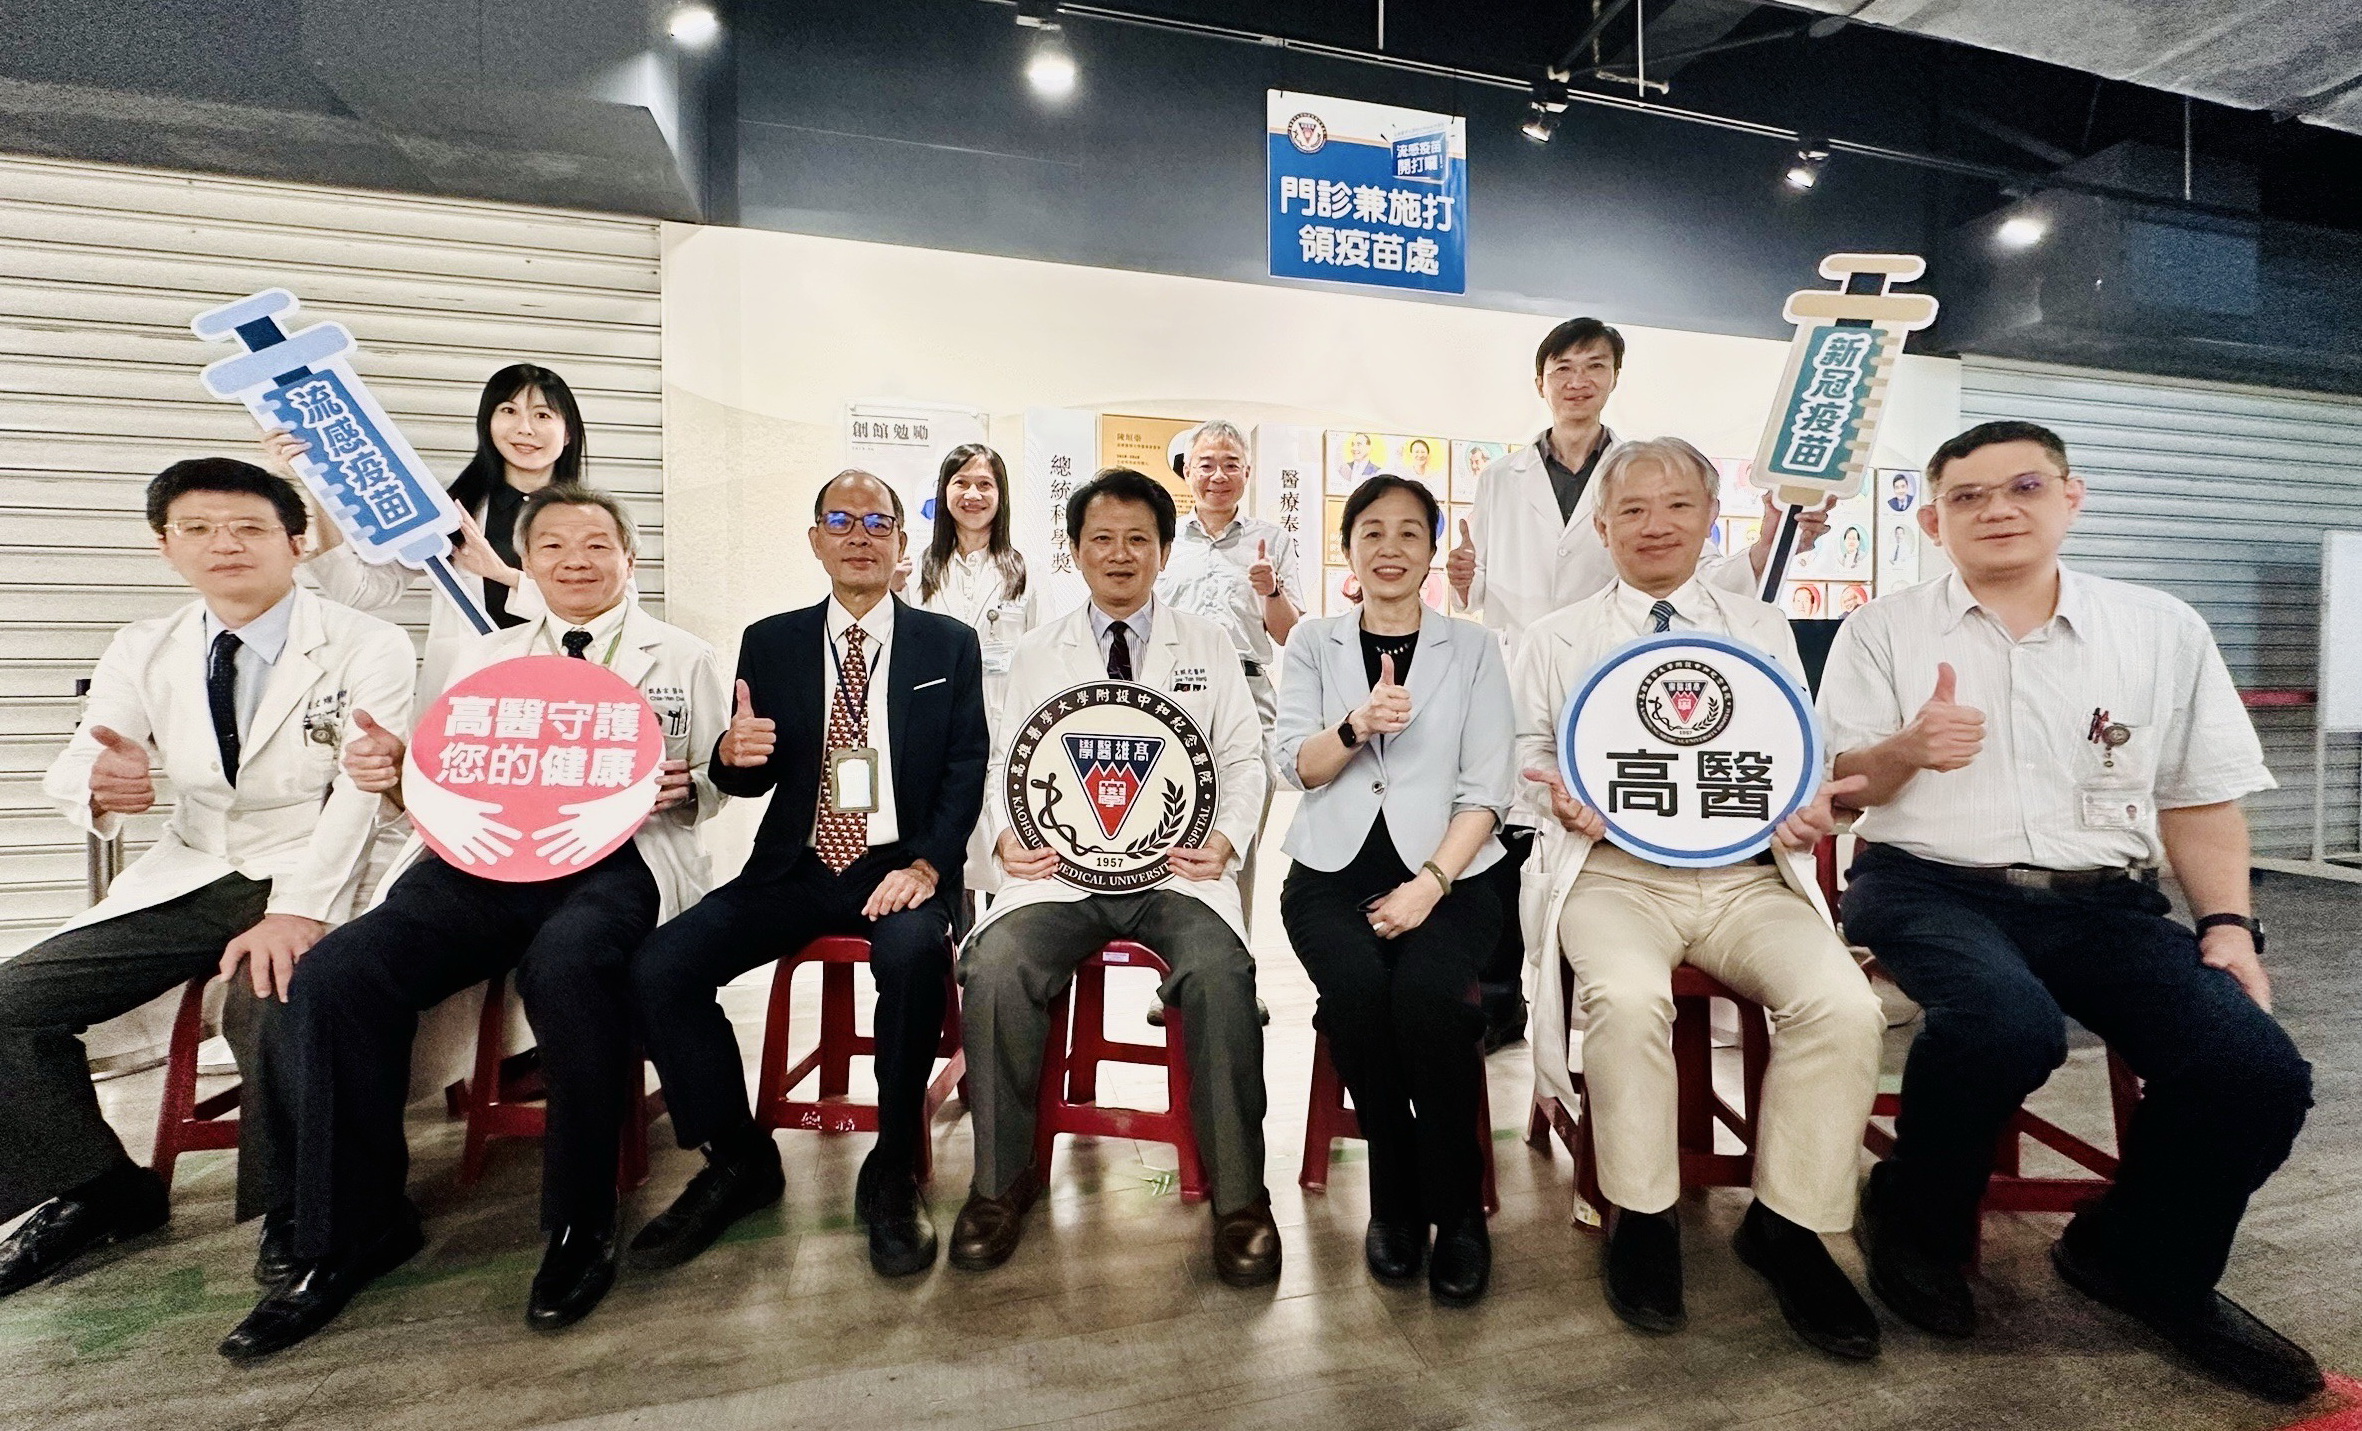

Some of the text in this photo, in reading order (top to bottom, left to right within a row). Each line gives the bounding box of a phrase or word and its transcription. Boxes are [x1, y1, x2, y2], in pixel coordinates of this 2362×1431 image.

[1396, 140, 1441, 158] 流感疫苗
[1280, 176, 1455, 232] 門診兼施打
[1298, 223, 1439, 276] 領疫苗處
[1786, 334, 1868, 470] 新冠疫苗
[291, 382, 414, 527] 流感疫苗
[1280, 469, 1300, 563] 醫療奉
[444, 695, 641, 743] 高醫守護
[435, 741, 637, 788] 您的健康
[1606, 749, 1773, 821] 高醫
[1012, 796, 1044, 849] KAOHSIU
[1109, 861, 1169, 886] UNIVERSIT
[1182, 805, 1211, 849] OSPITAL
[1096, 857, 1123, 867] 1957
